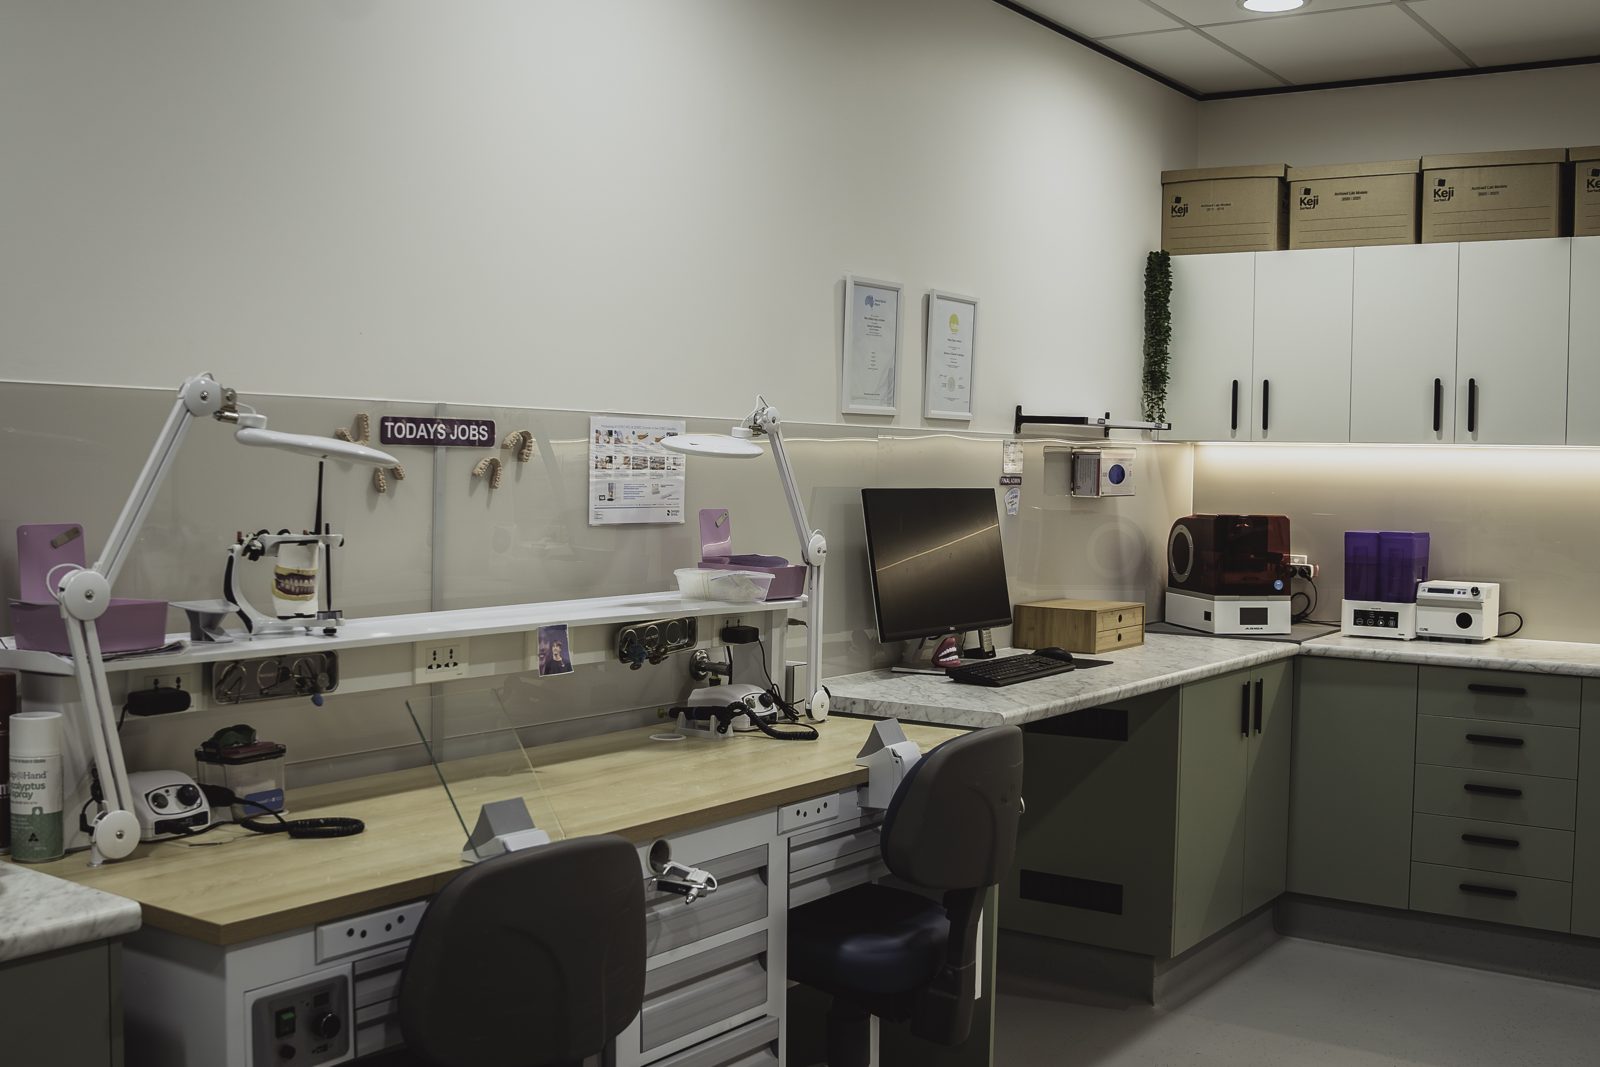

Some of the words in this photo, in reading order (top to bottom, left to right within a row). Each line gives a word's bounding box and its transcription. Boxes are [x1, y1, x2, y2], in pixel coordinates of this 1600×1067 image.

[1586, 178, 1600, 189] Ke
[1433, 186, 1455, 201] Keji
[1300, 195, 1319, 209] Keji
[1171, 203, 1189, 217] Keji
[384, 421, 447, 440] TODAYS
[449, 424, 489, 441] JOBS
